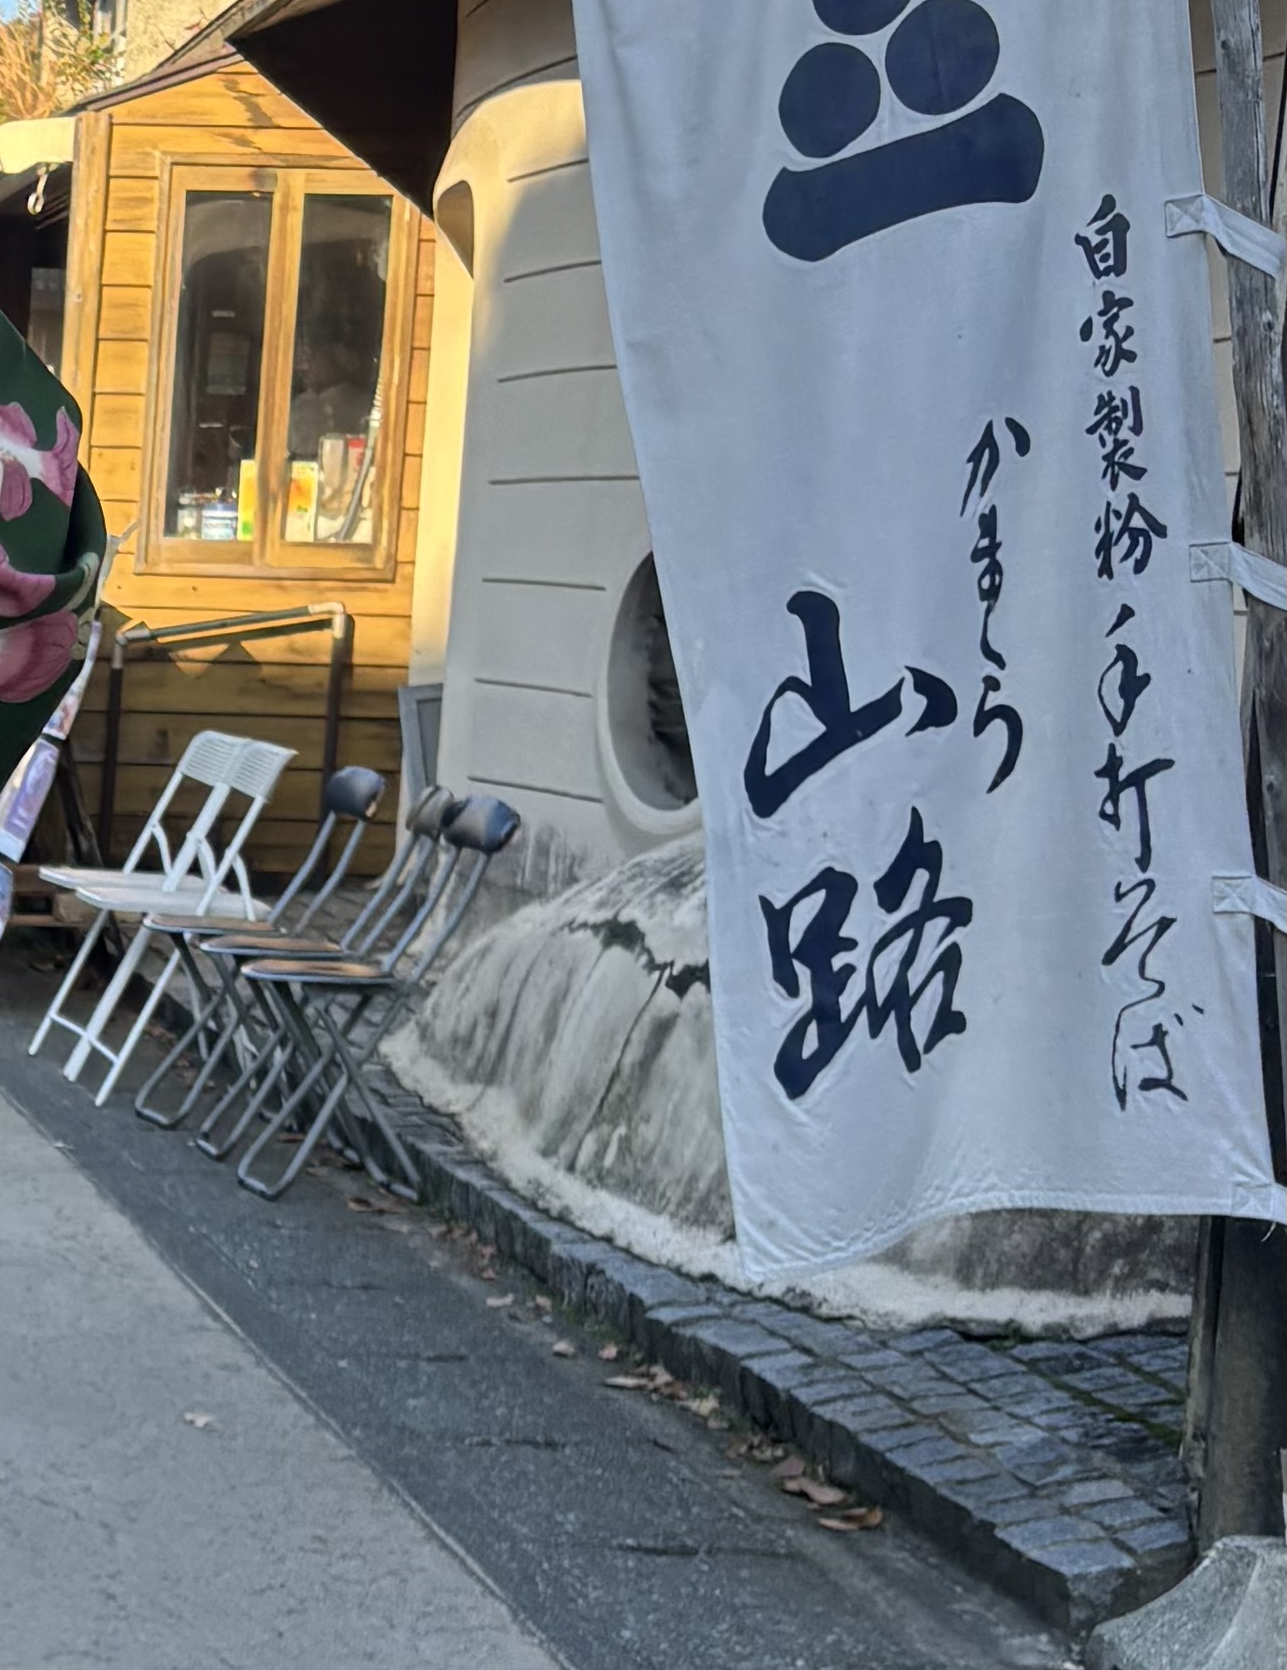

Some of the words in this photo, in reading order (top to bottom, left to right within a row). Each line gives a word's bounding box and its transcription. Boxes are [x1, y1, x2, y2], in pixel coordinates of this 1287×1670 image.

[743, 590, 974, 1101] 山路
[1074, 193, 1205, 1111] 自家製粉手打そば
